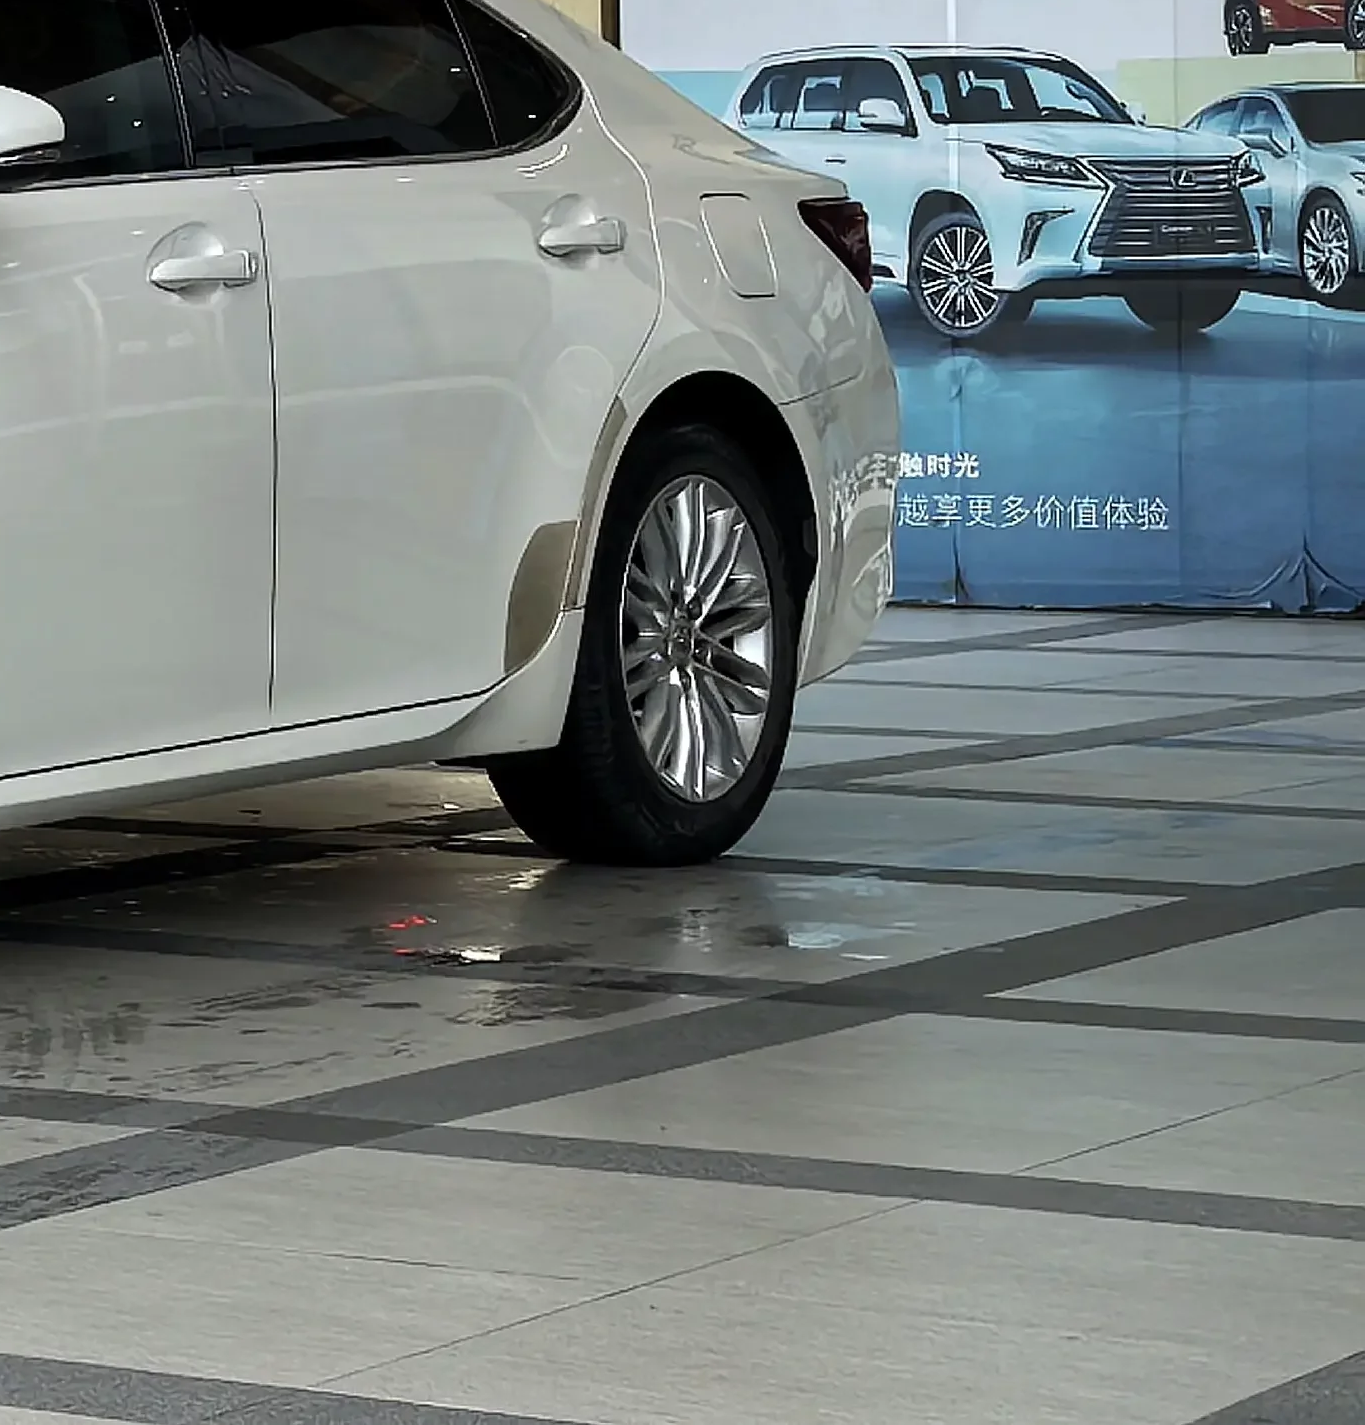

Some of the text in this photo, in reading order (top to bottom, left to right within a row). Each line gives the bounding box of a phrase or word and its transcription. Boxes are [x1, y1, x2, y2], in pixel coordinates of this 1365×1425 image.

[897, 492, 1170, 532] 越享更多价值体验
